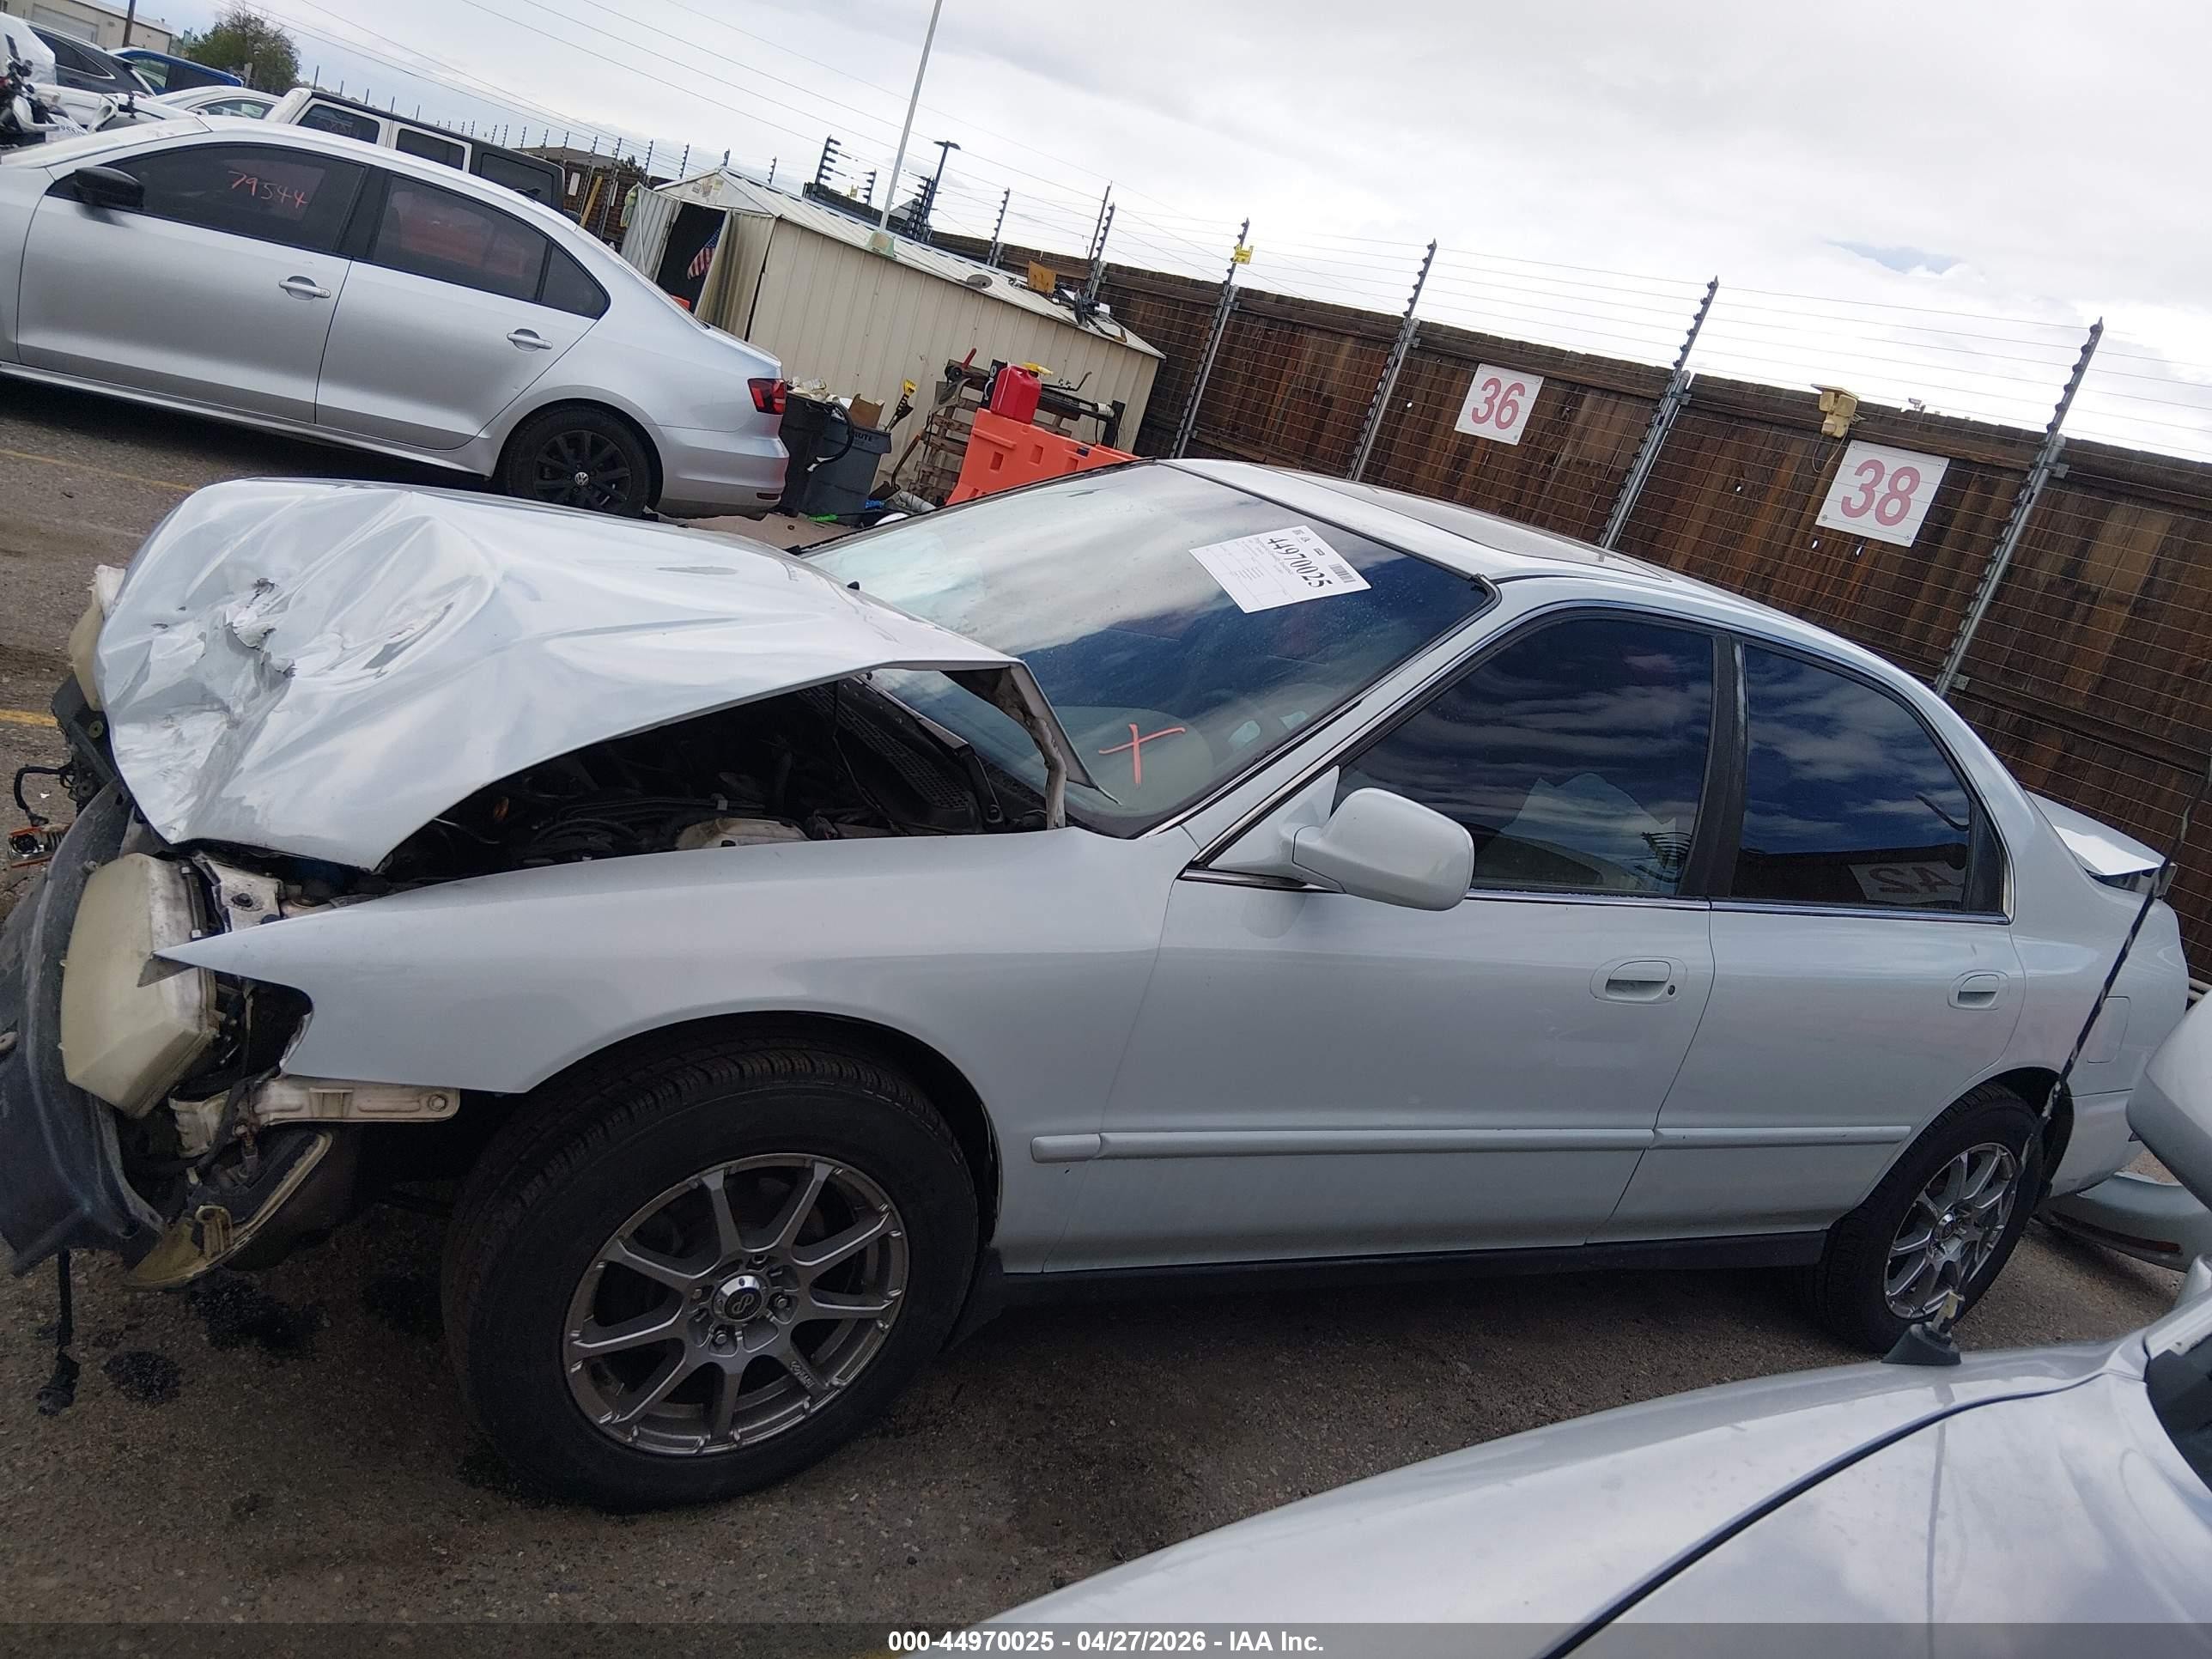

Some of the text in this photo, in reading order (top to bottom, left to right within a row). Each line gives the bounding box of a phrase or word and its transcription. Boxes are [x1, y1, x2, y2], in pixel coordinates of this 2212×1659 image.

[228, 170, 309, 209] 79544
[1471, 377, 1526, 430] 36
[1840, 459, 1921, 527] 38
[1267, 538, 1334, 588] 44970025
